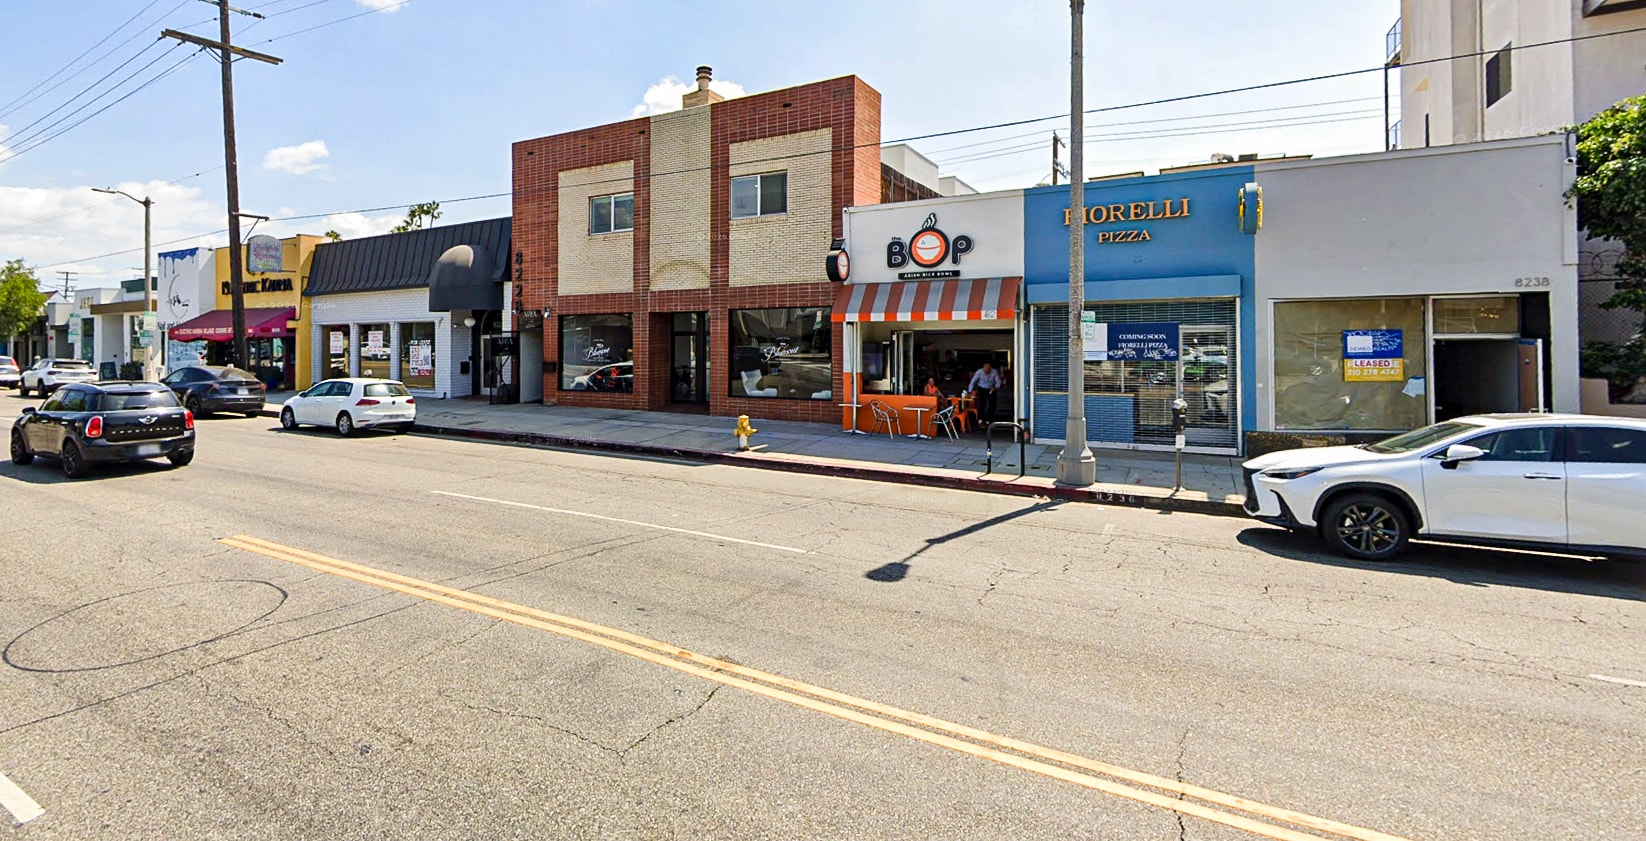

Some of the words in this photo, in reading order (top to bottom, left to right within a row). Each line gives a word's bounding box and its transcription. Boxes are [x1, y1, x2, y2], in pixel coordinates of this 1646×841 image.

[1098, 229, 1151, 243] PIZZA
[261, 278, 293, 292] KARMA
[1515, 277, 1550, 287] 8238
[1380, 368, 1400, 376] 4747
